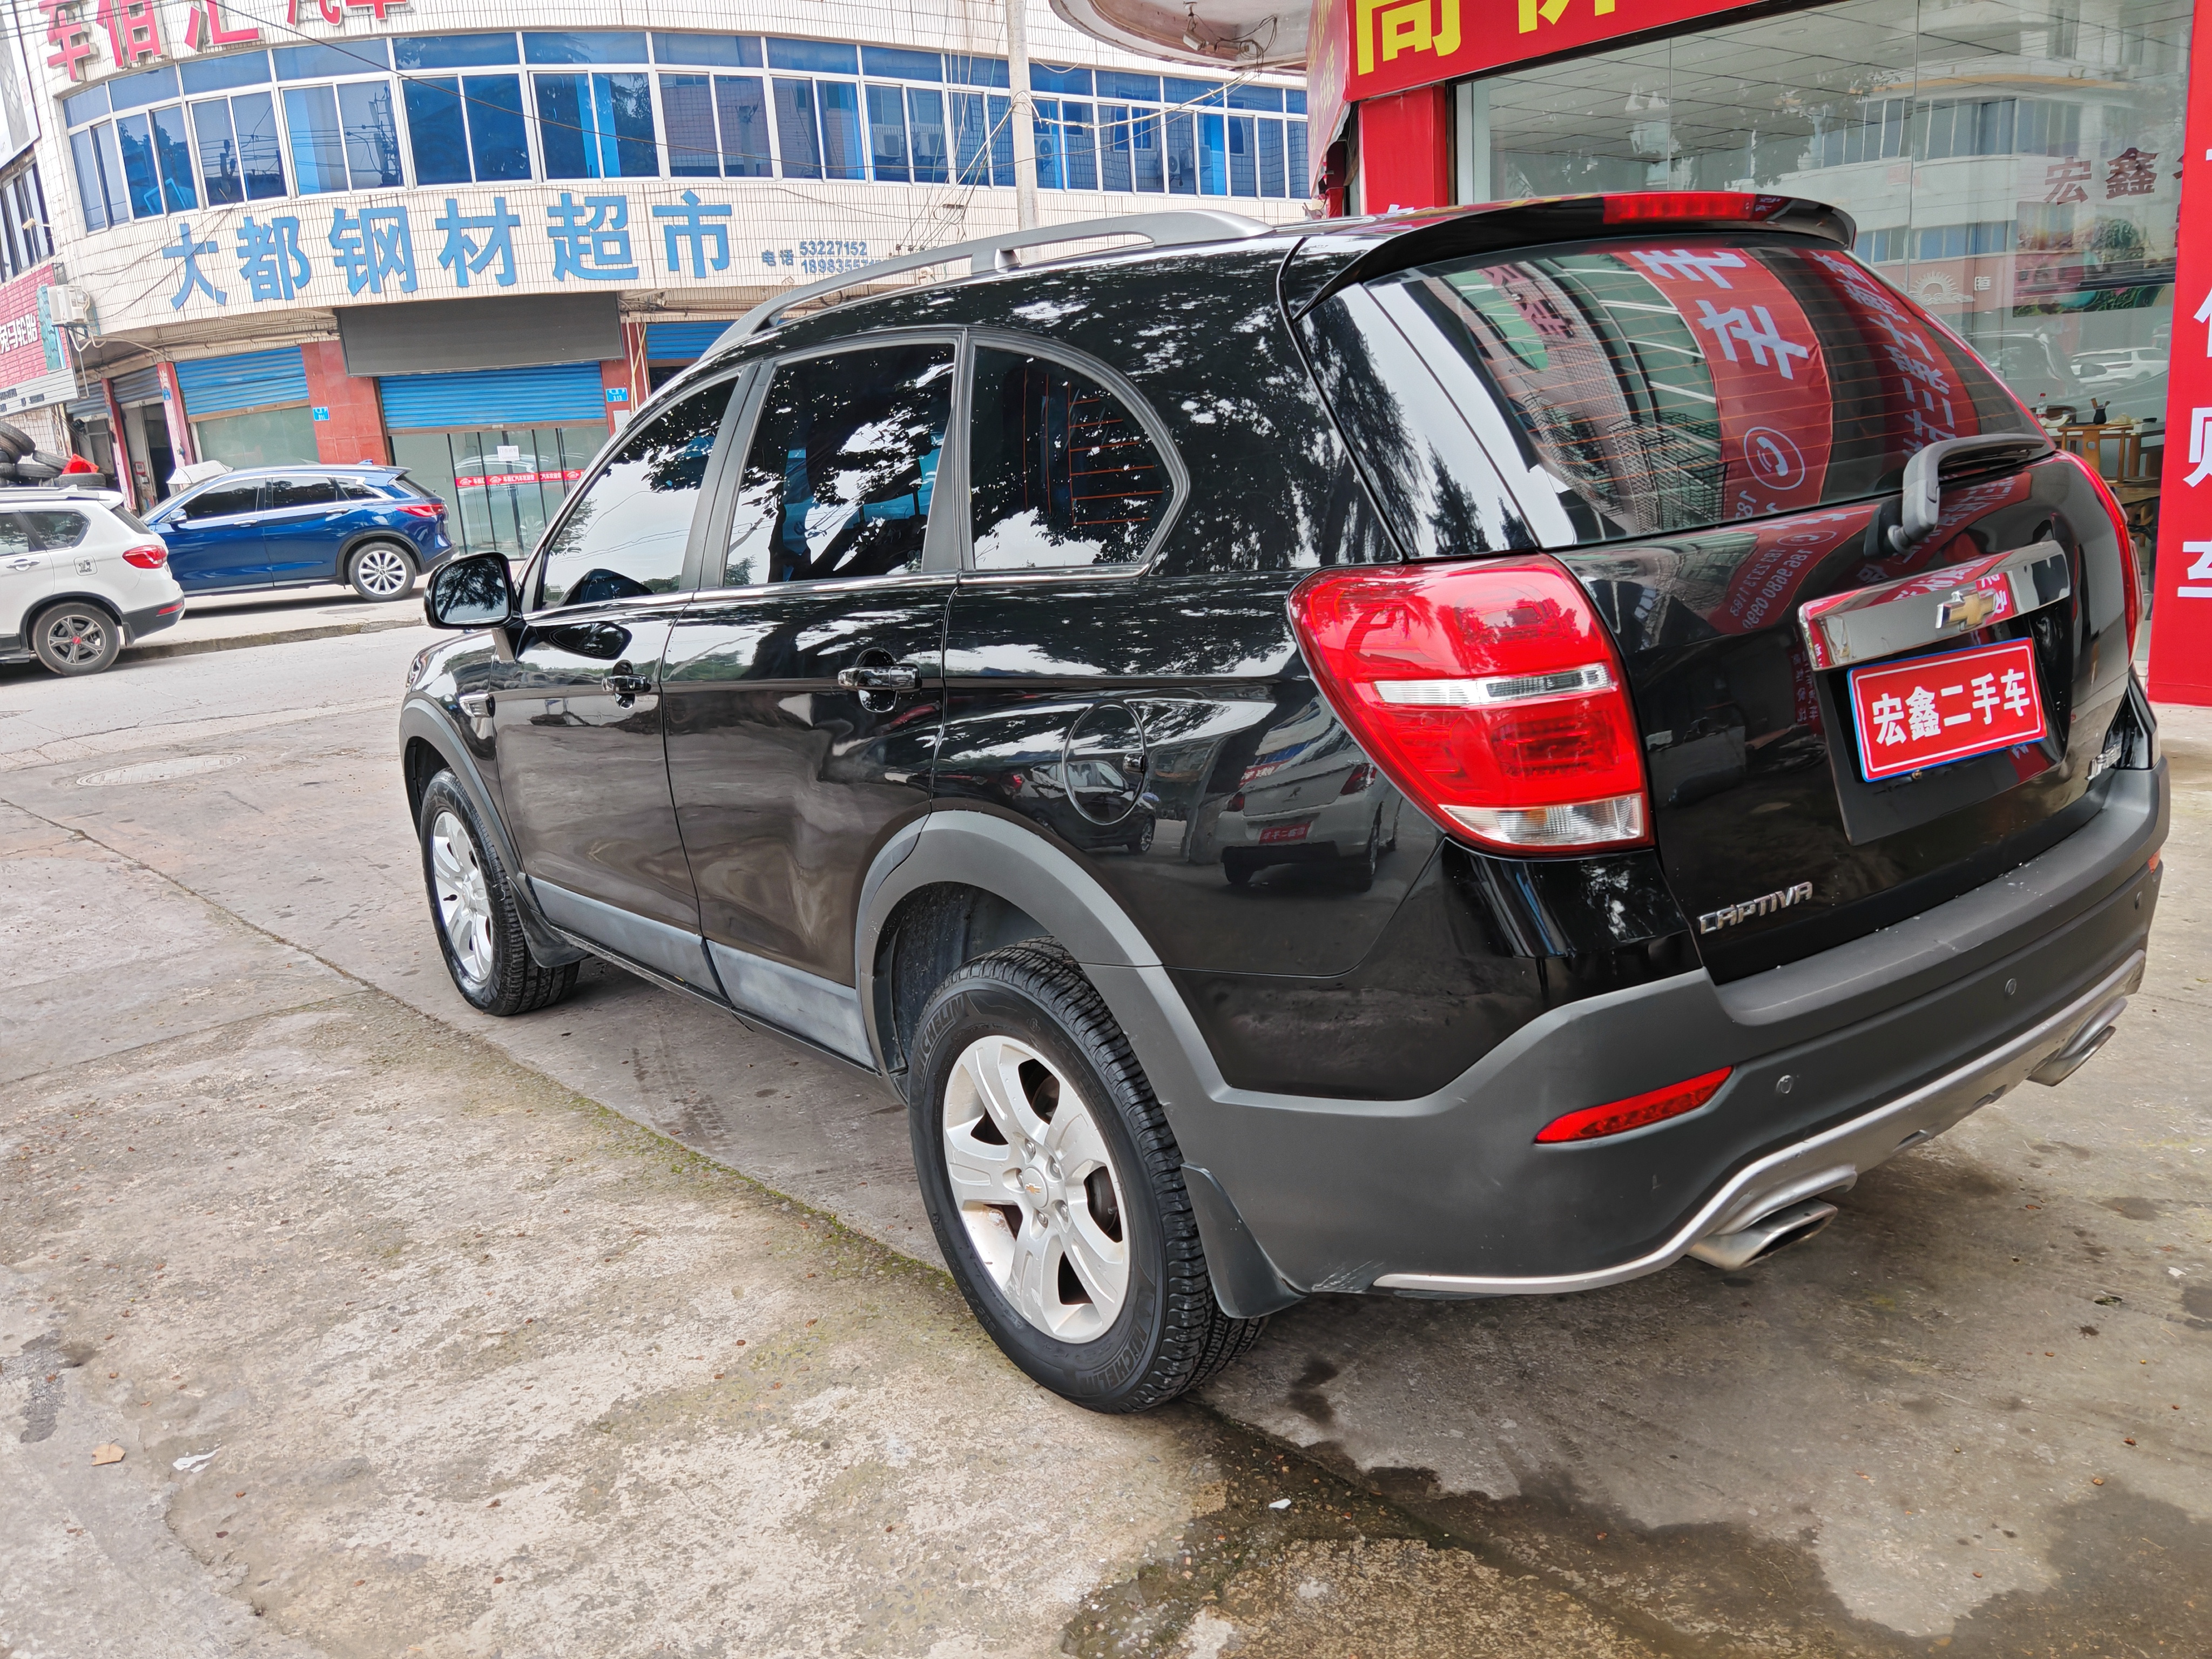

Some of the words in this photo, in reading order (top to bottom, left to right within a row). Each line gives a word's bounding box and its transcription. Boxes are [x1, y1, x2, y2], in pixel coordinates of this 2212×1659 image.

[161, 189, 732, 311] 大都钢材超市
[761, 249, 794, 267] 电话
[799, 240, 867, 256] 53227152
[1871, 668, 2031, 746] 宏鑫二手车
[1700, 881, 1813, 935] CAPTIVA
